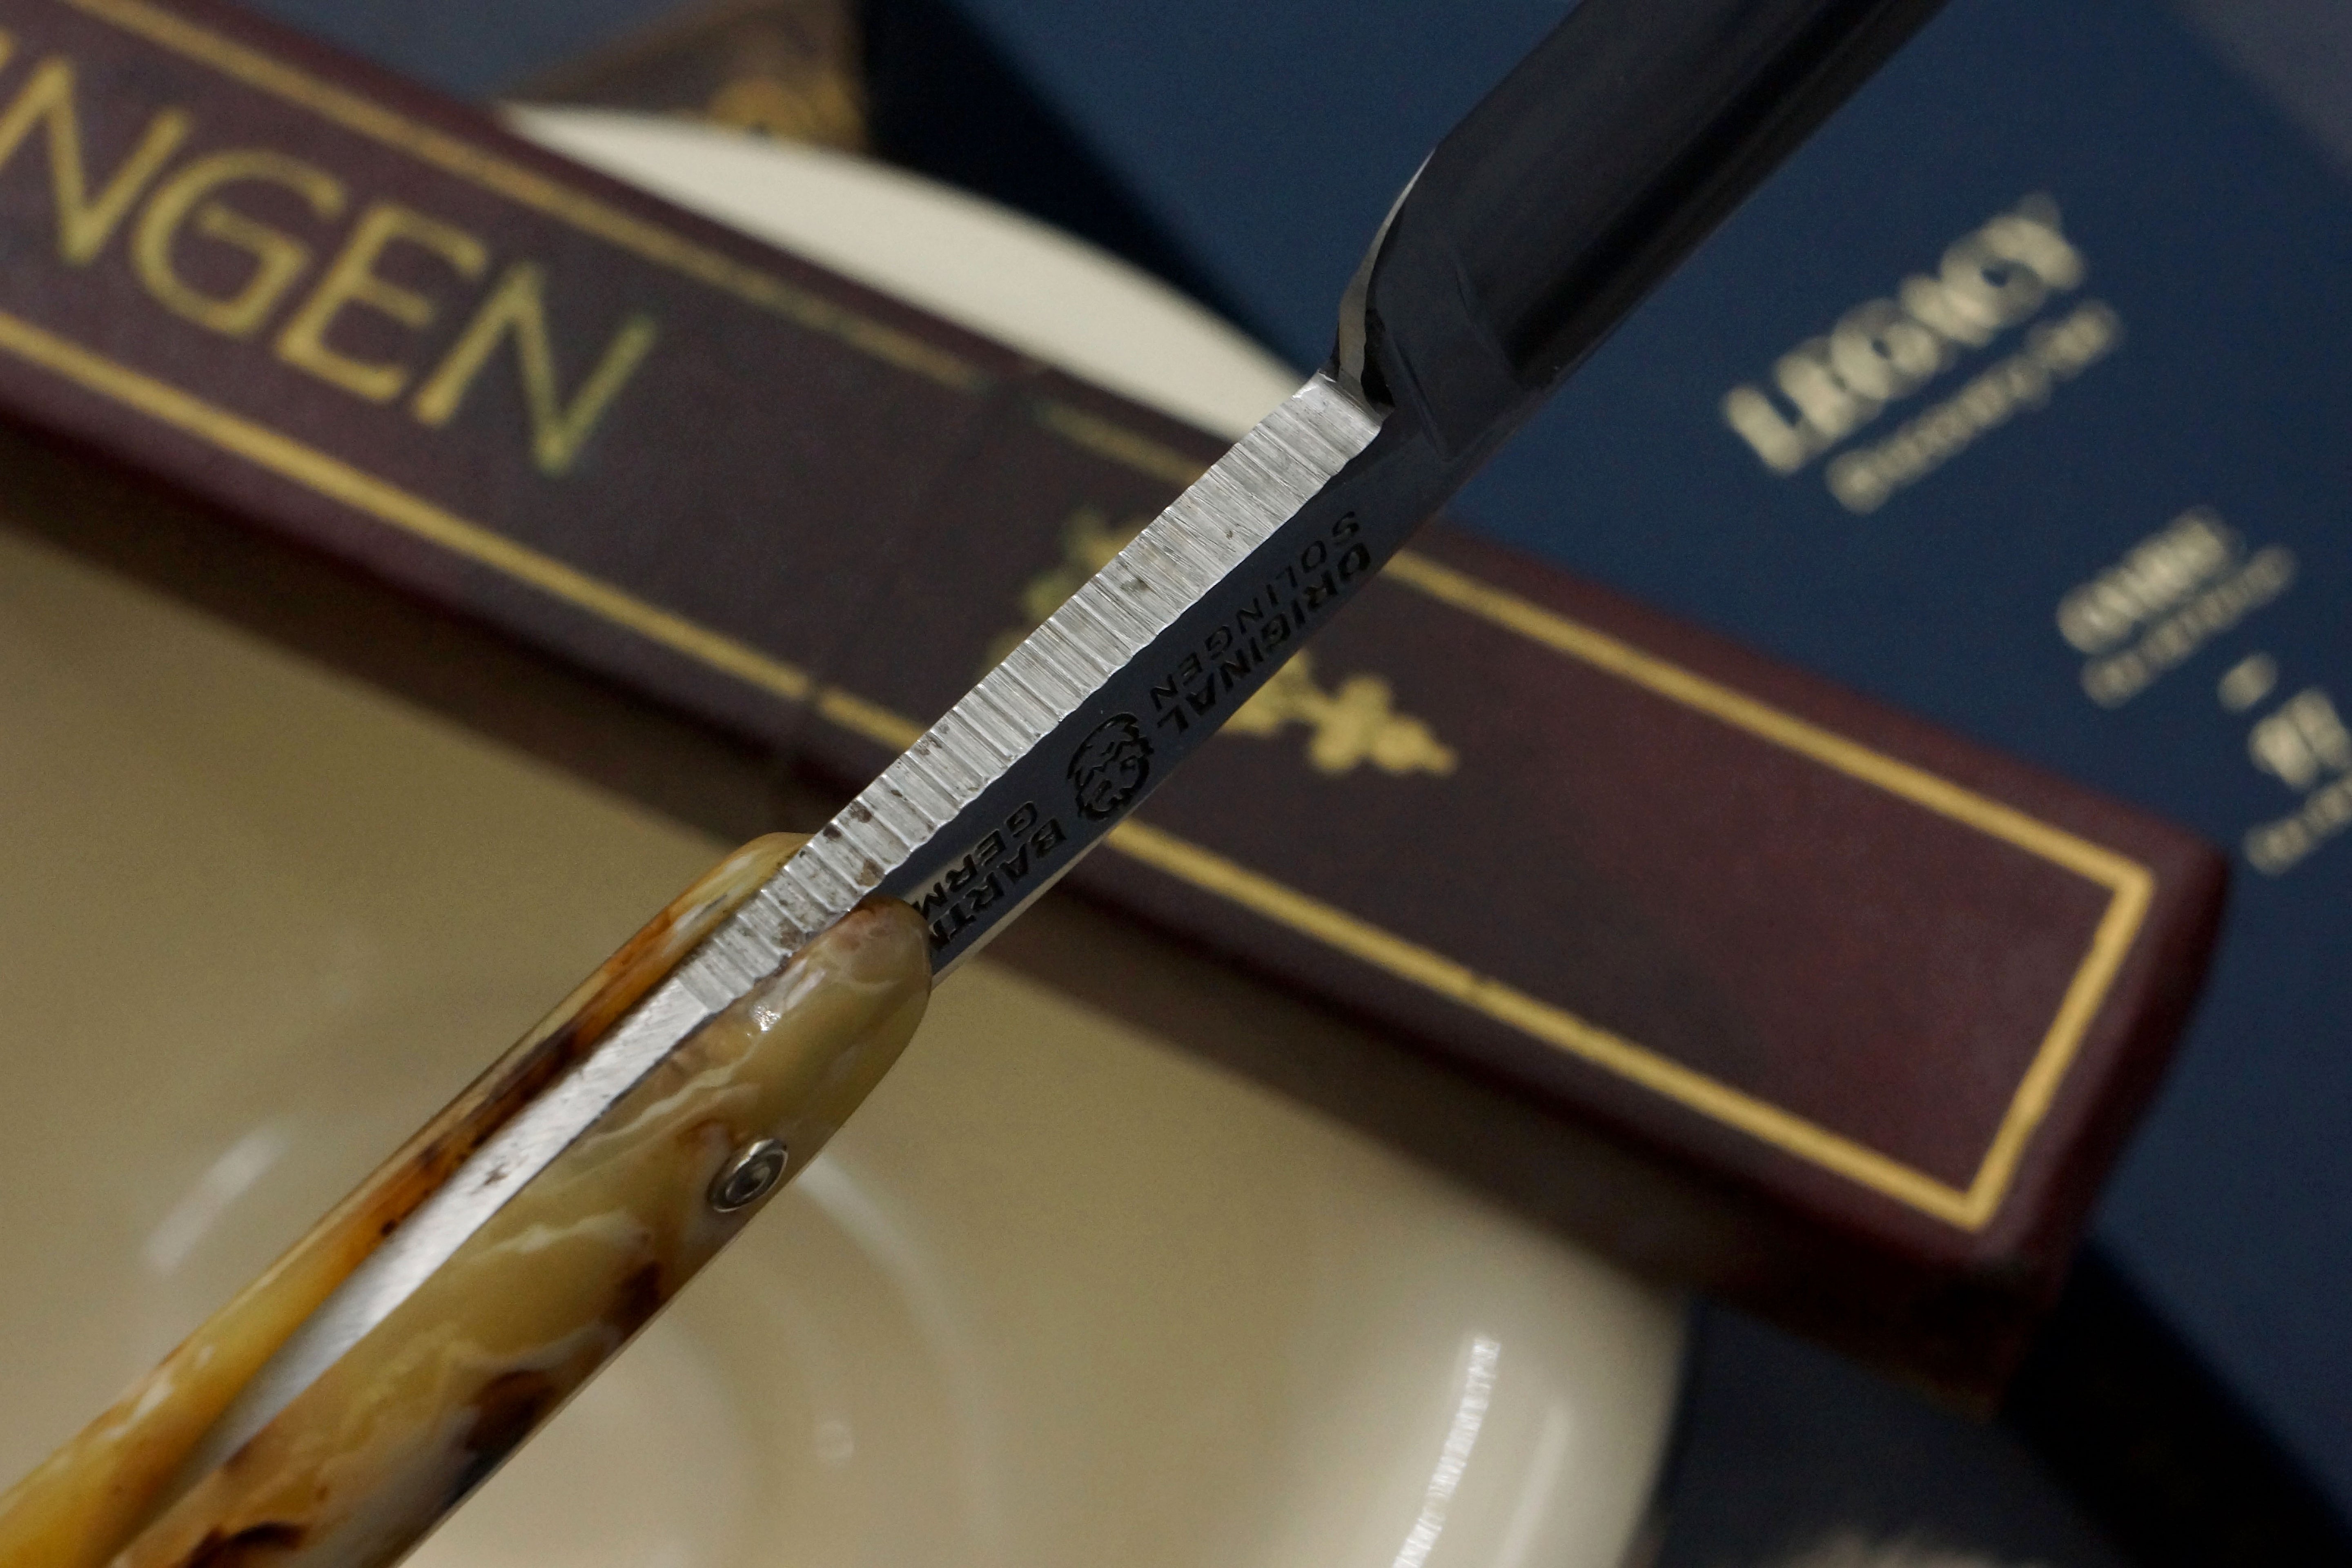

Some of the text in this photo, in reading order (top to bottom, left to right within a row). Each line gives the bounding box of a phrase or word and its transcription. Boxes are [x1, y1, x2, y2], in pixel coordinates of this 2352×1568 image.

[0, 31, 655, 476] NGEN
[1151, 512, 1359, 709] SOLINGEN
[1159, 543, 1370, 733] ORIGINAL
